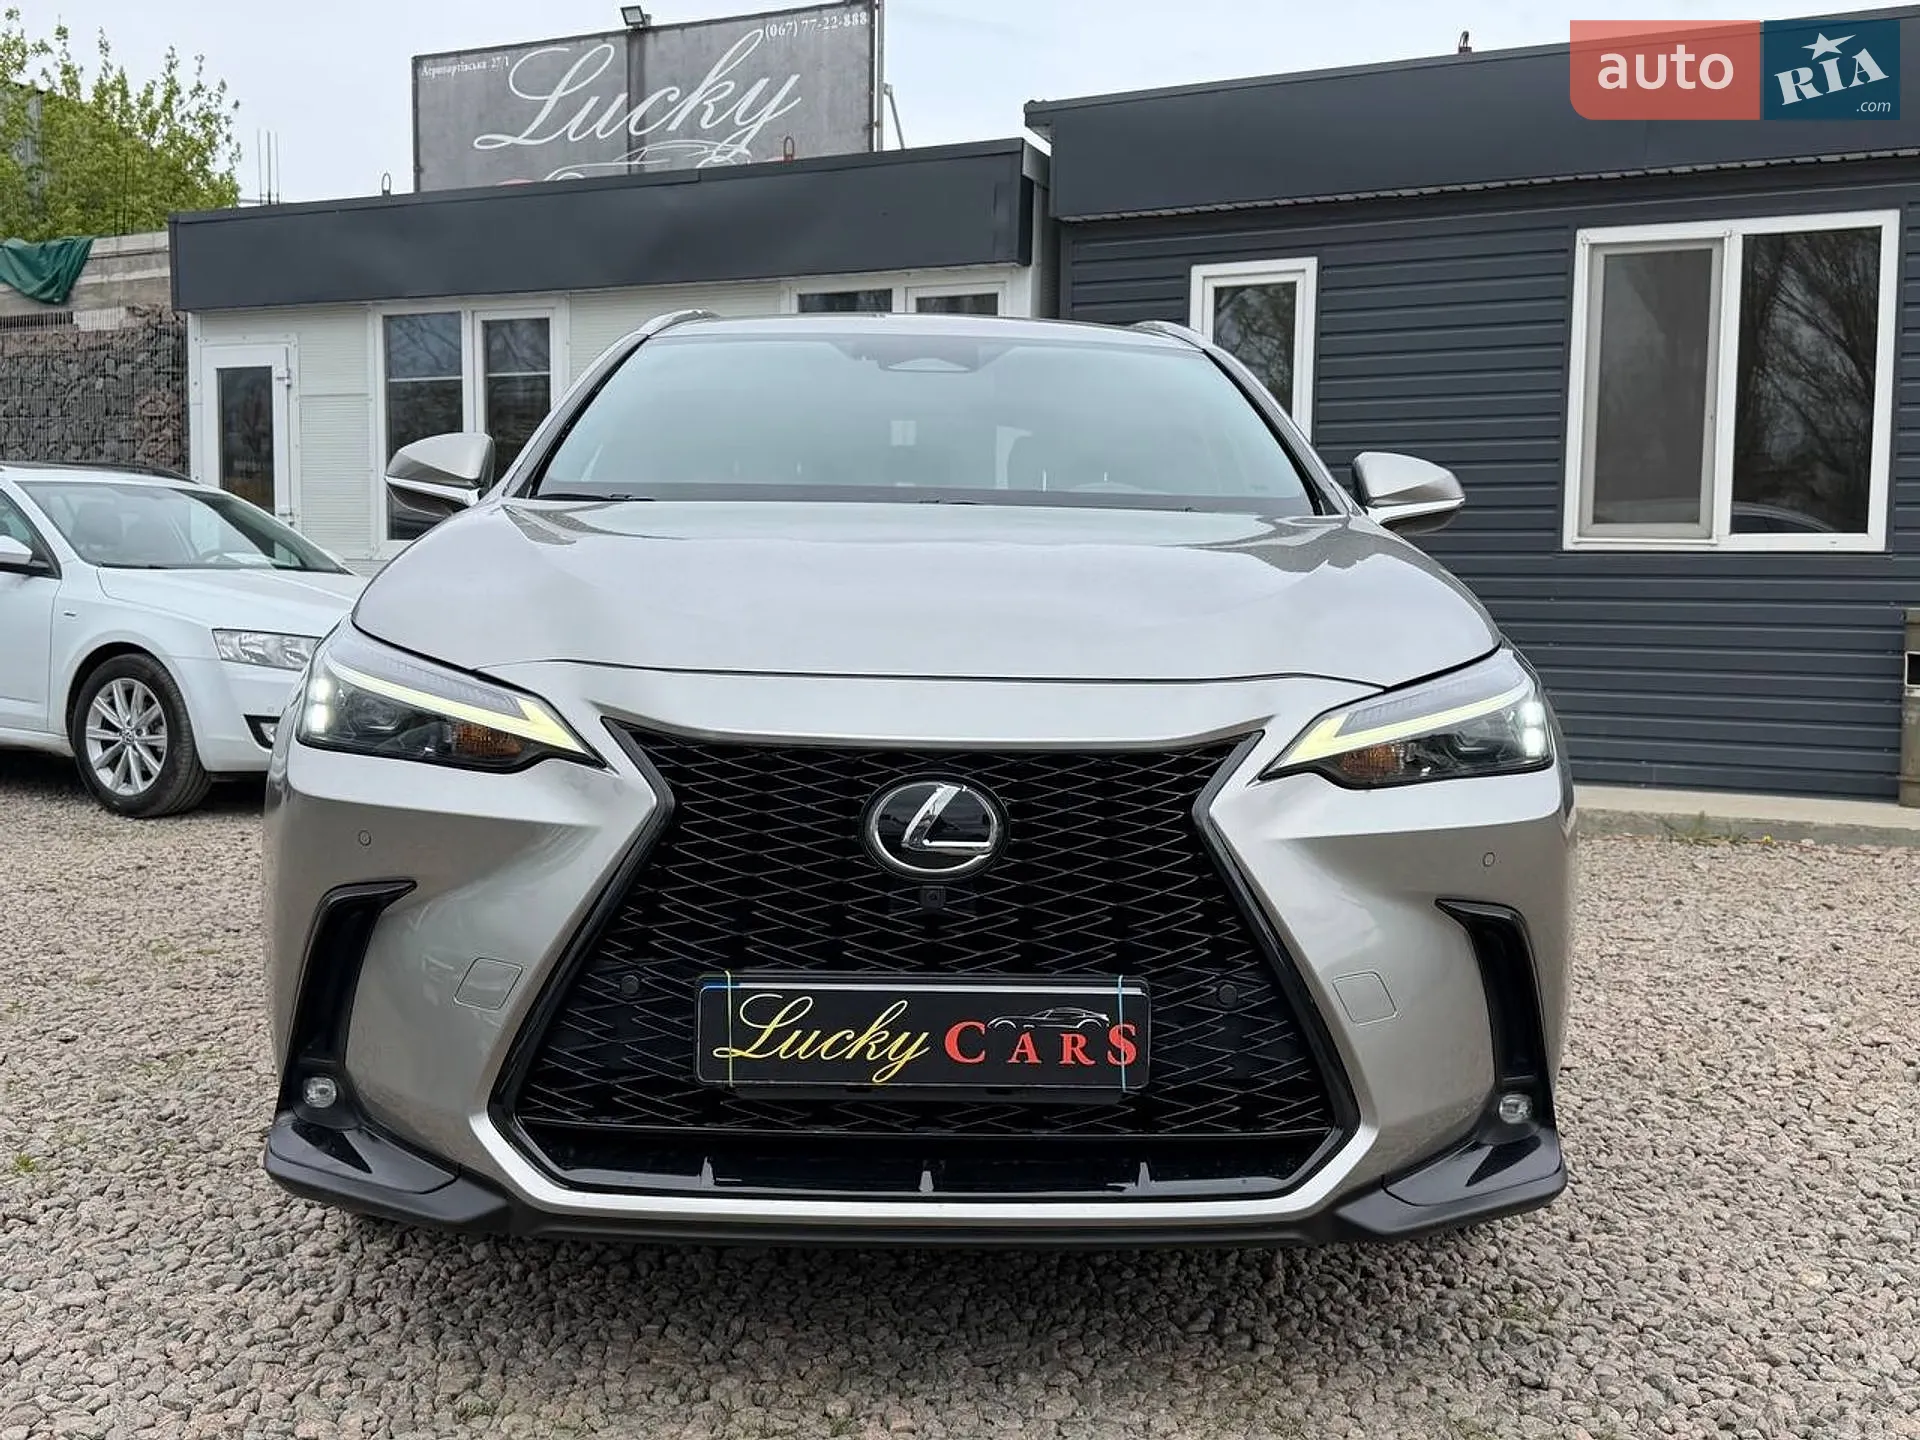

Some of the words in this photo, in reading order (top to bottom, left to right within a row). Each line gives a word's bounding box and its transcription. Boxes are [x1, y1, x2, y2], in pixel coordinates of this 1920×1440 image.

[473, 29, 801, 166] Lucky
[713, 993, 930, 1084] Lucky
[944, 1020, 1138, 1066] CARS
